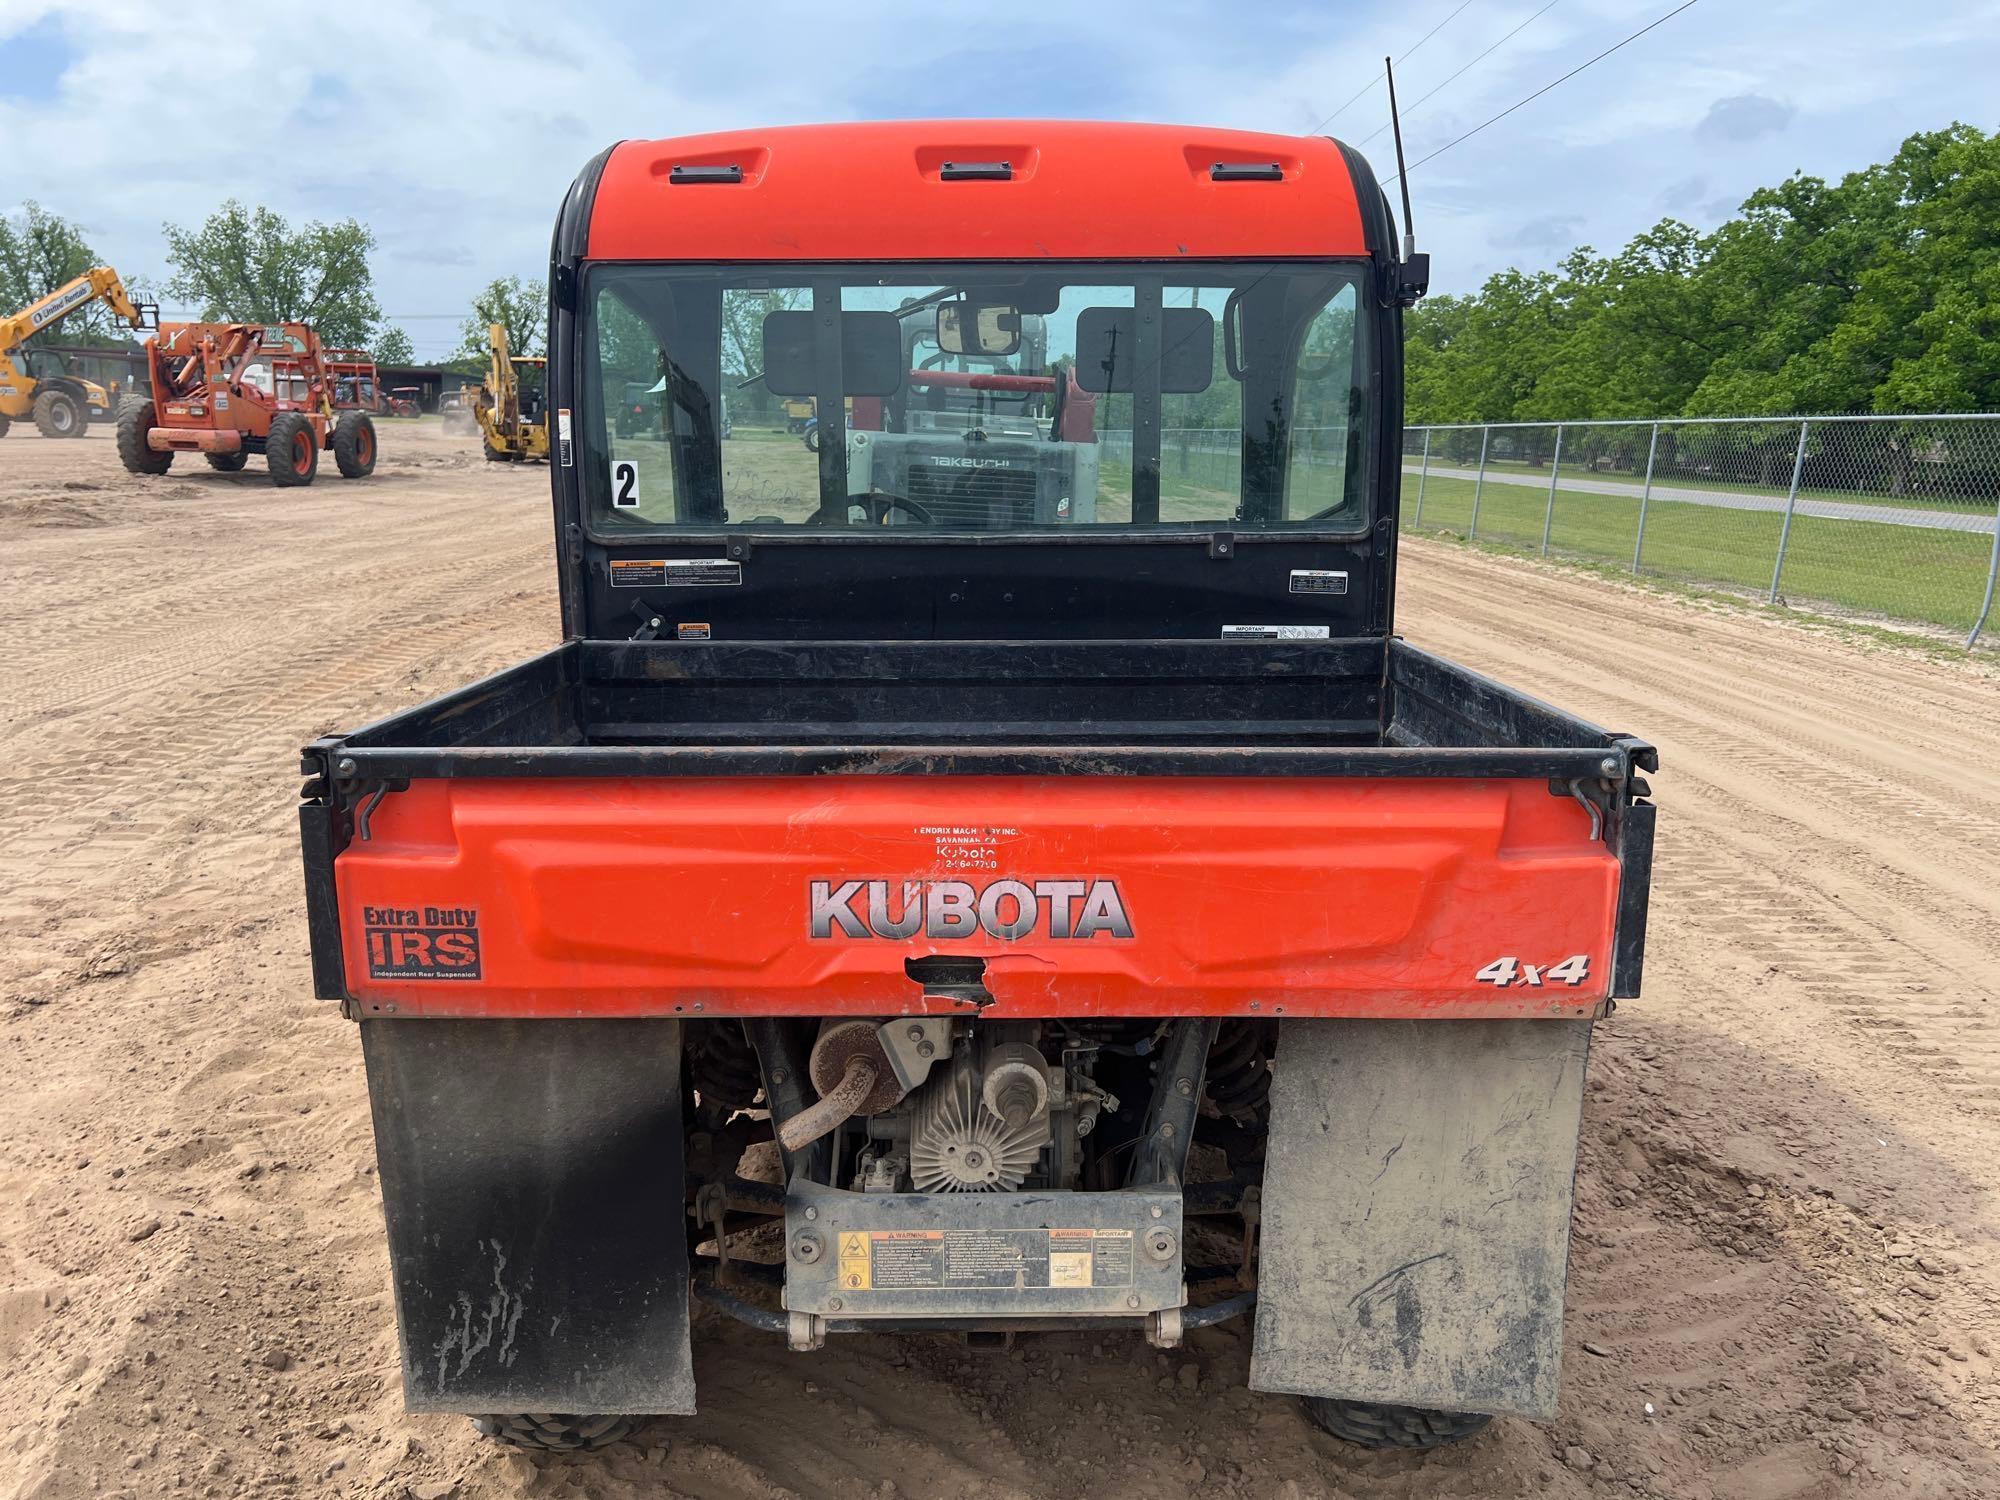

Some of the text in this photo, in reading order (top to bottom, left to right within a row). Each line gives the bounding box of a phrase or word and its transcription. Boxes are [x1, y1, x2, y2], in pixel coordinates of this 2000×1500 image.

[44, 287, 88, 318] United Rentals
[616, 463, 637, 507] 2
[364, 907, 476, 927] Extra Duty
[810, 880, 1135, 940] KUBOTA
[371, 932, 476, 967] IRS
[1475, 955, 1591, 987] 4x4
